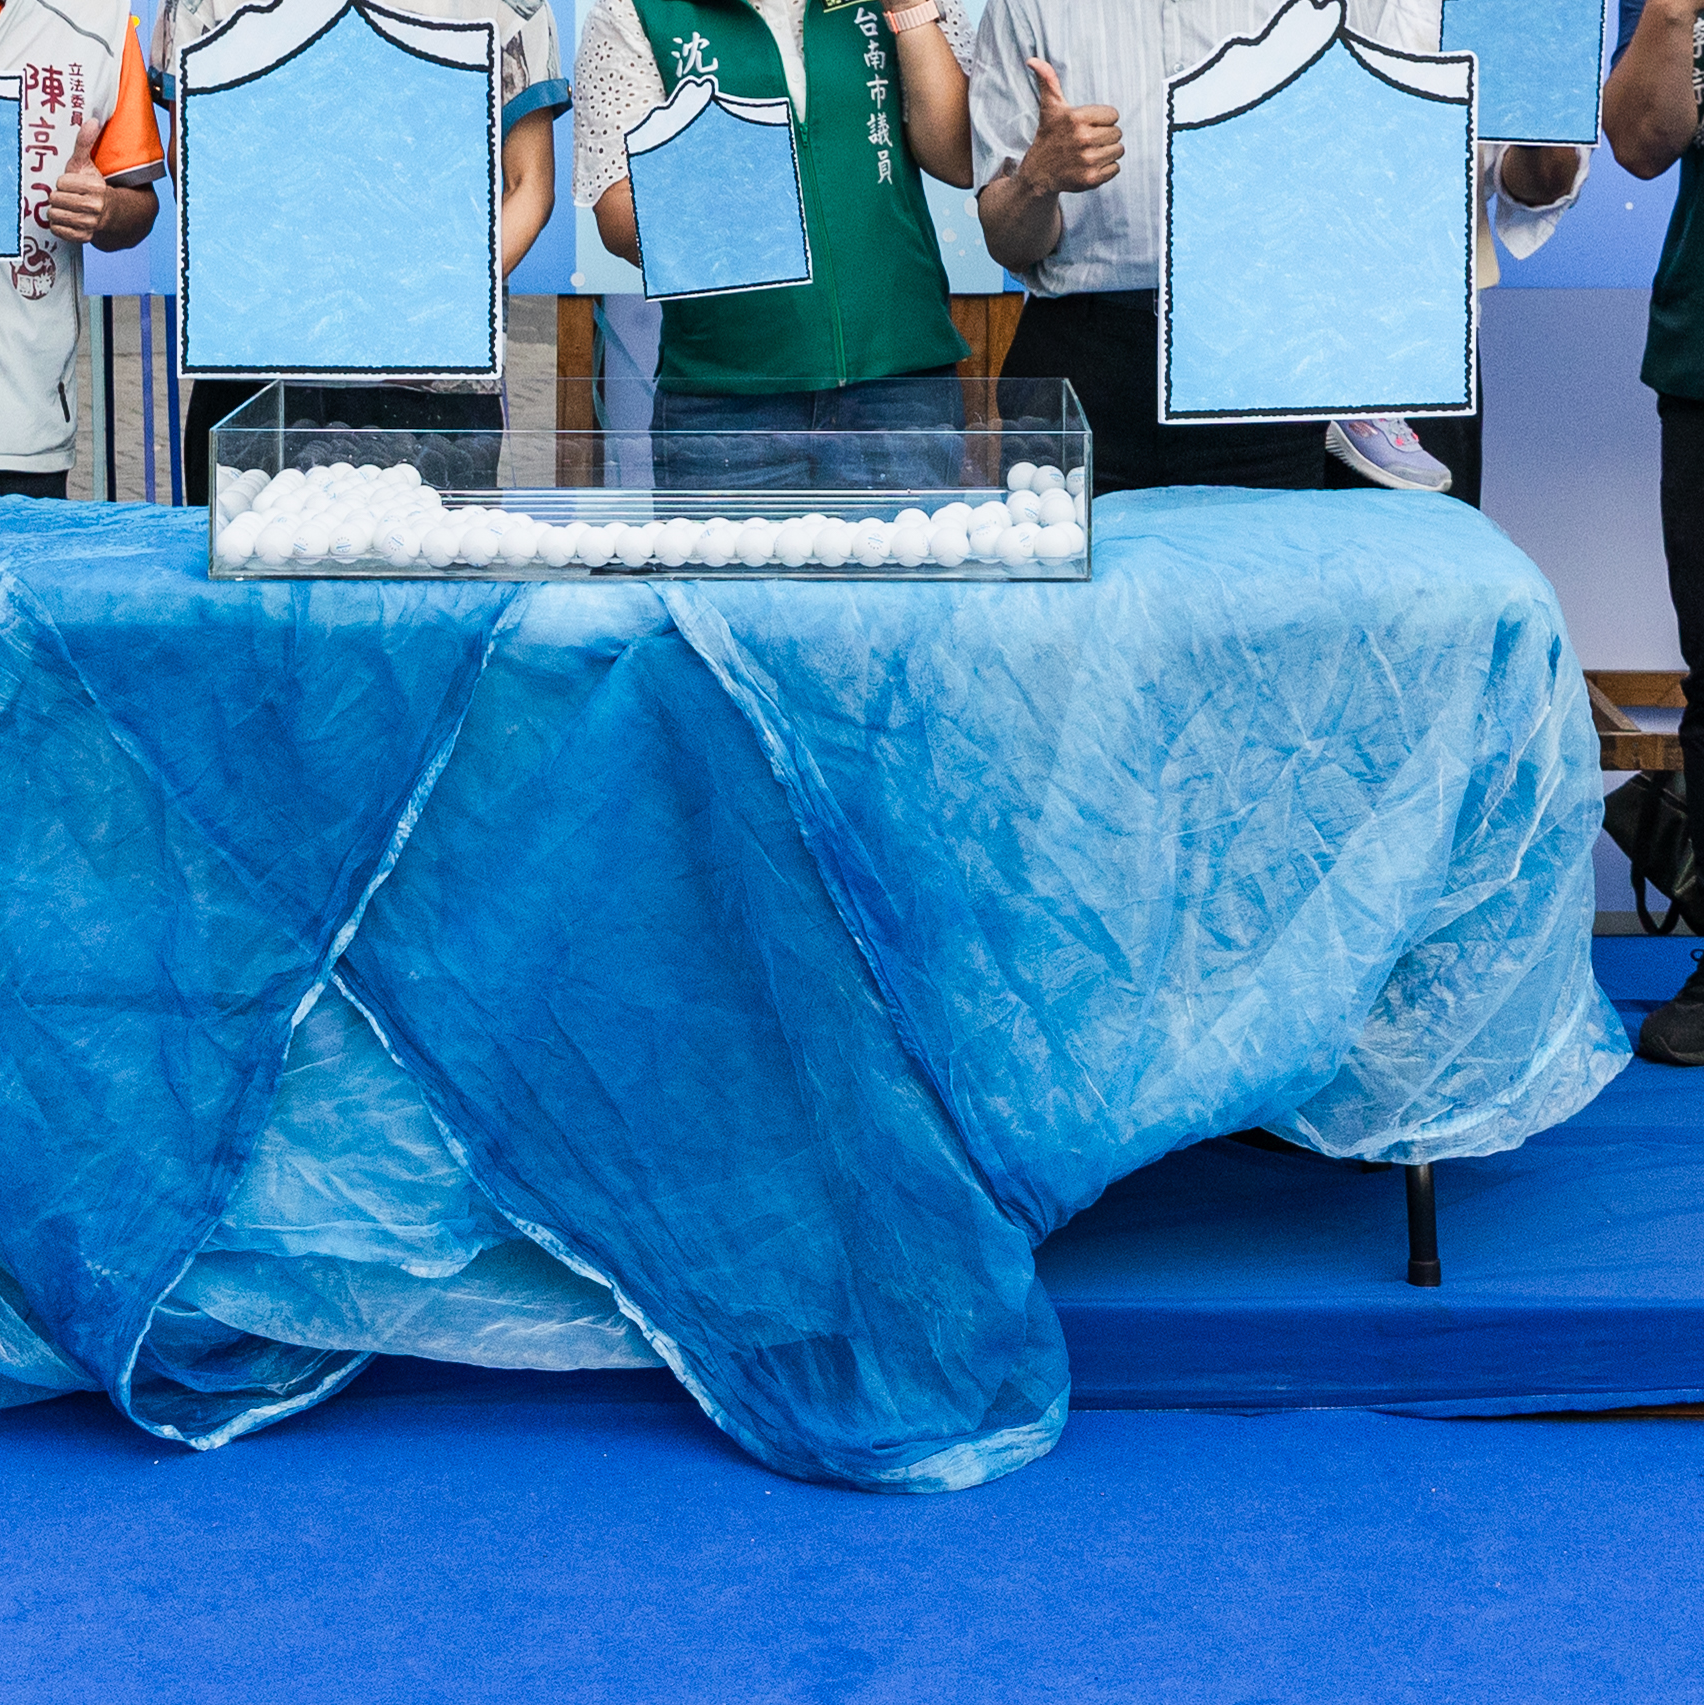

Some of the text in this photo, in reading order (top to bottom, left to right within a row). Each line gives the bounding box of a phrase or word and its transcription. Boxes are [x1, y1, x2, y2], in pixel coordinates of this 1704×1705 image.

[670, 31, 719, 78] 沈
[69, 62, 85, 127] 立法委員
[853, 7, 893, 185] 台南市議員
